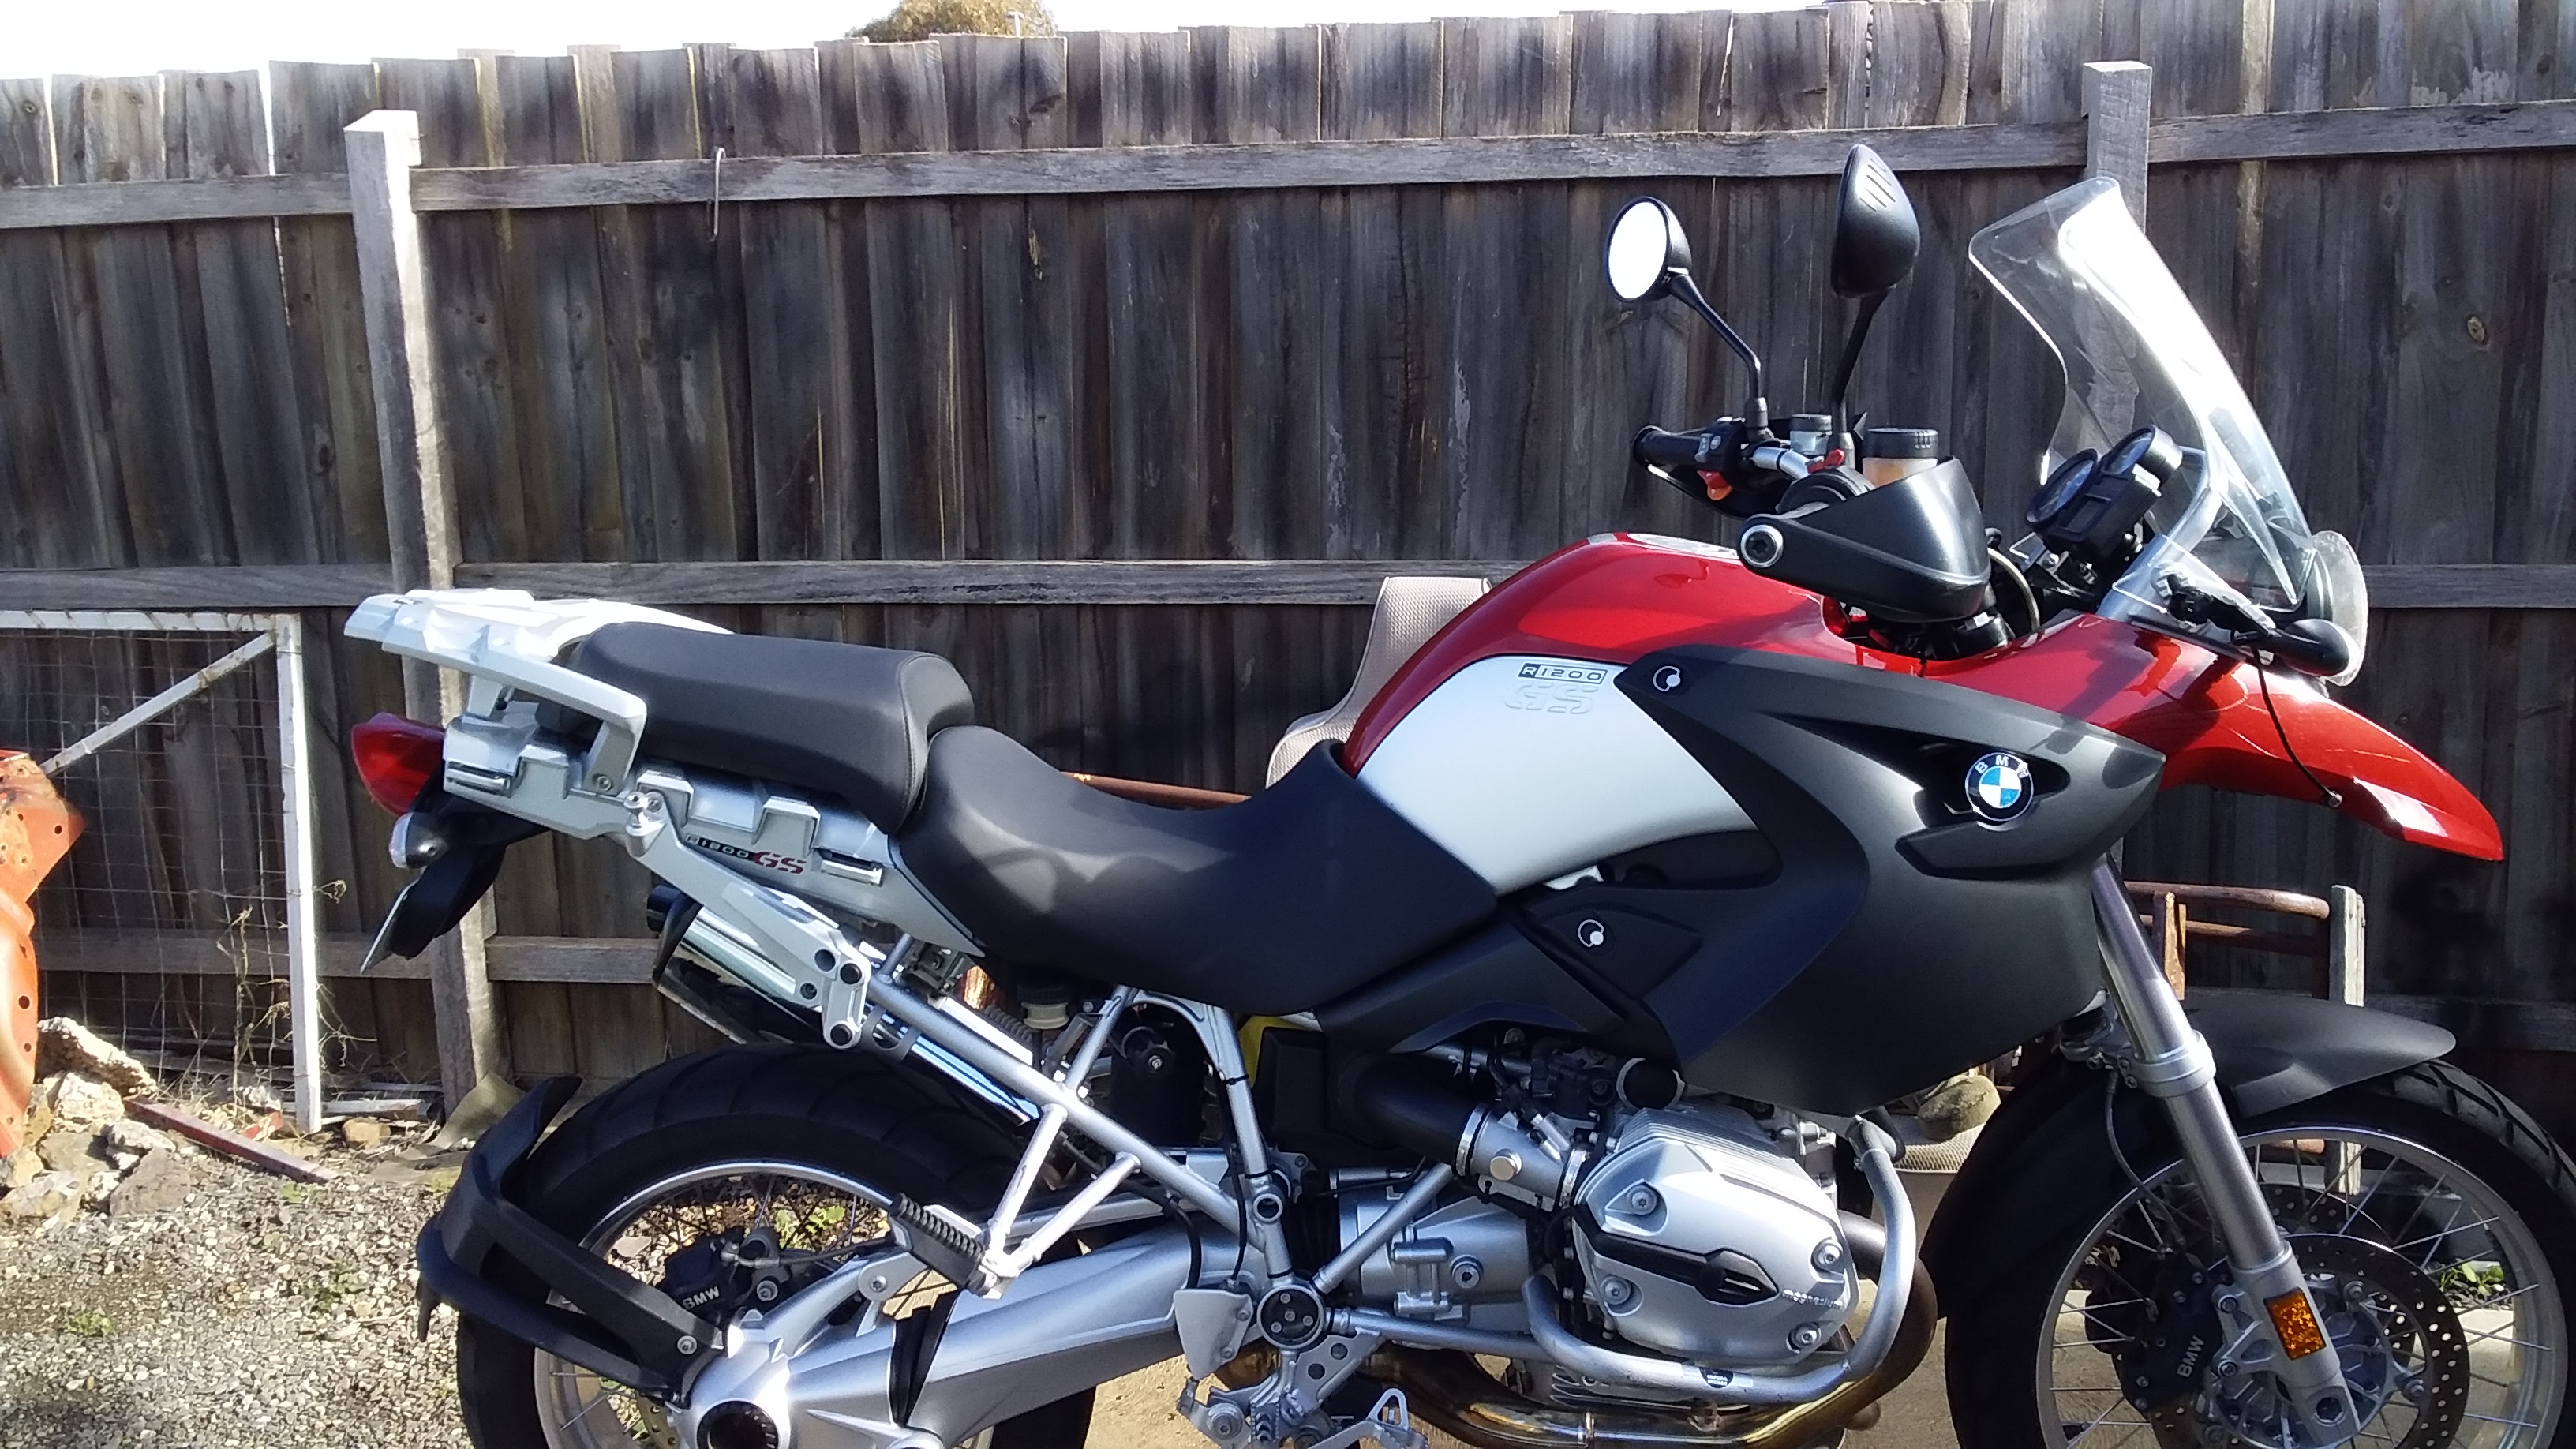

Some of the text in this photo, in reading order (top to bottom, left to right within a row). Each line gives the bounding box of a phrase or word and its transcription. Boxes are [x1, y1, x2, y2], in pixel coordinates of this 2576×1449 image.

[1520, 665, 1604, 682] R1200
[1503, 683, 1599, 715] GS
[1974, 754, 2029, 779] BMW
[753, 851, 807, 874] GS
[682, 1286, 720, 1310] BMW
[2177, 1335, 2205, 1378] BMW
